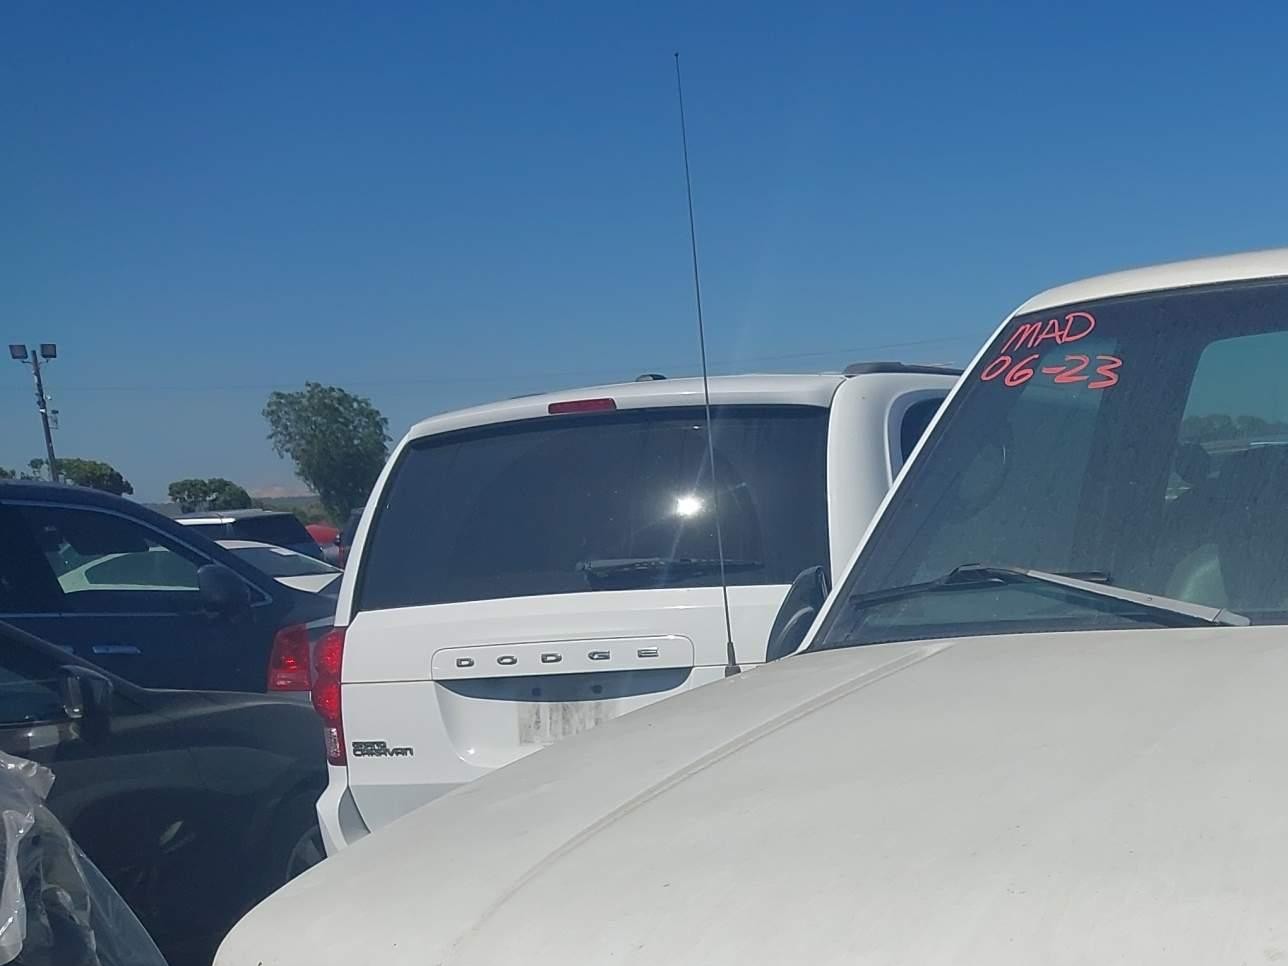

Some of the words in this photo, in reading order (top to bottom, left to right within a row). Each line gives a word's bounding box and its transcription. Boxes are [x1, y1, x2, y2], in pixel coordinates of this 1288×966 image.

[1001, 311, 1096, 353] MAD
[980, 354, 1123, 389] 06-23
[456, 647, 660, 668] DODGE
